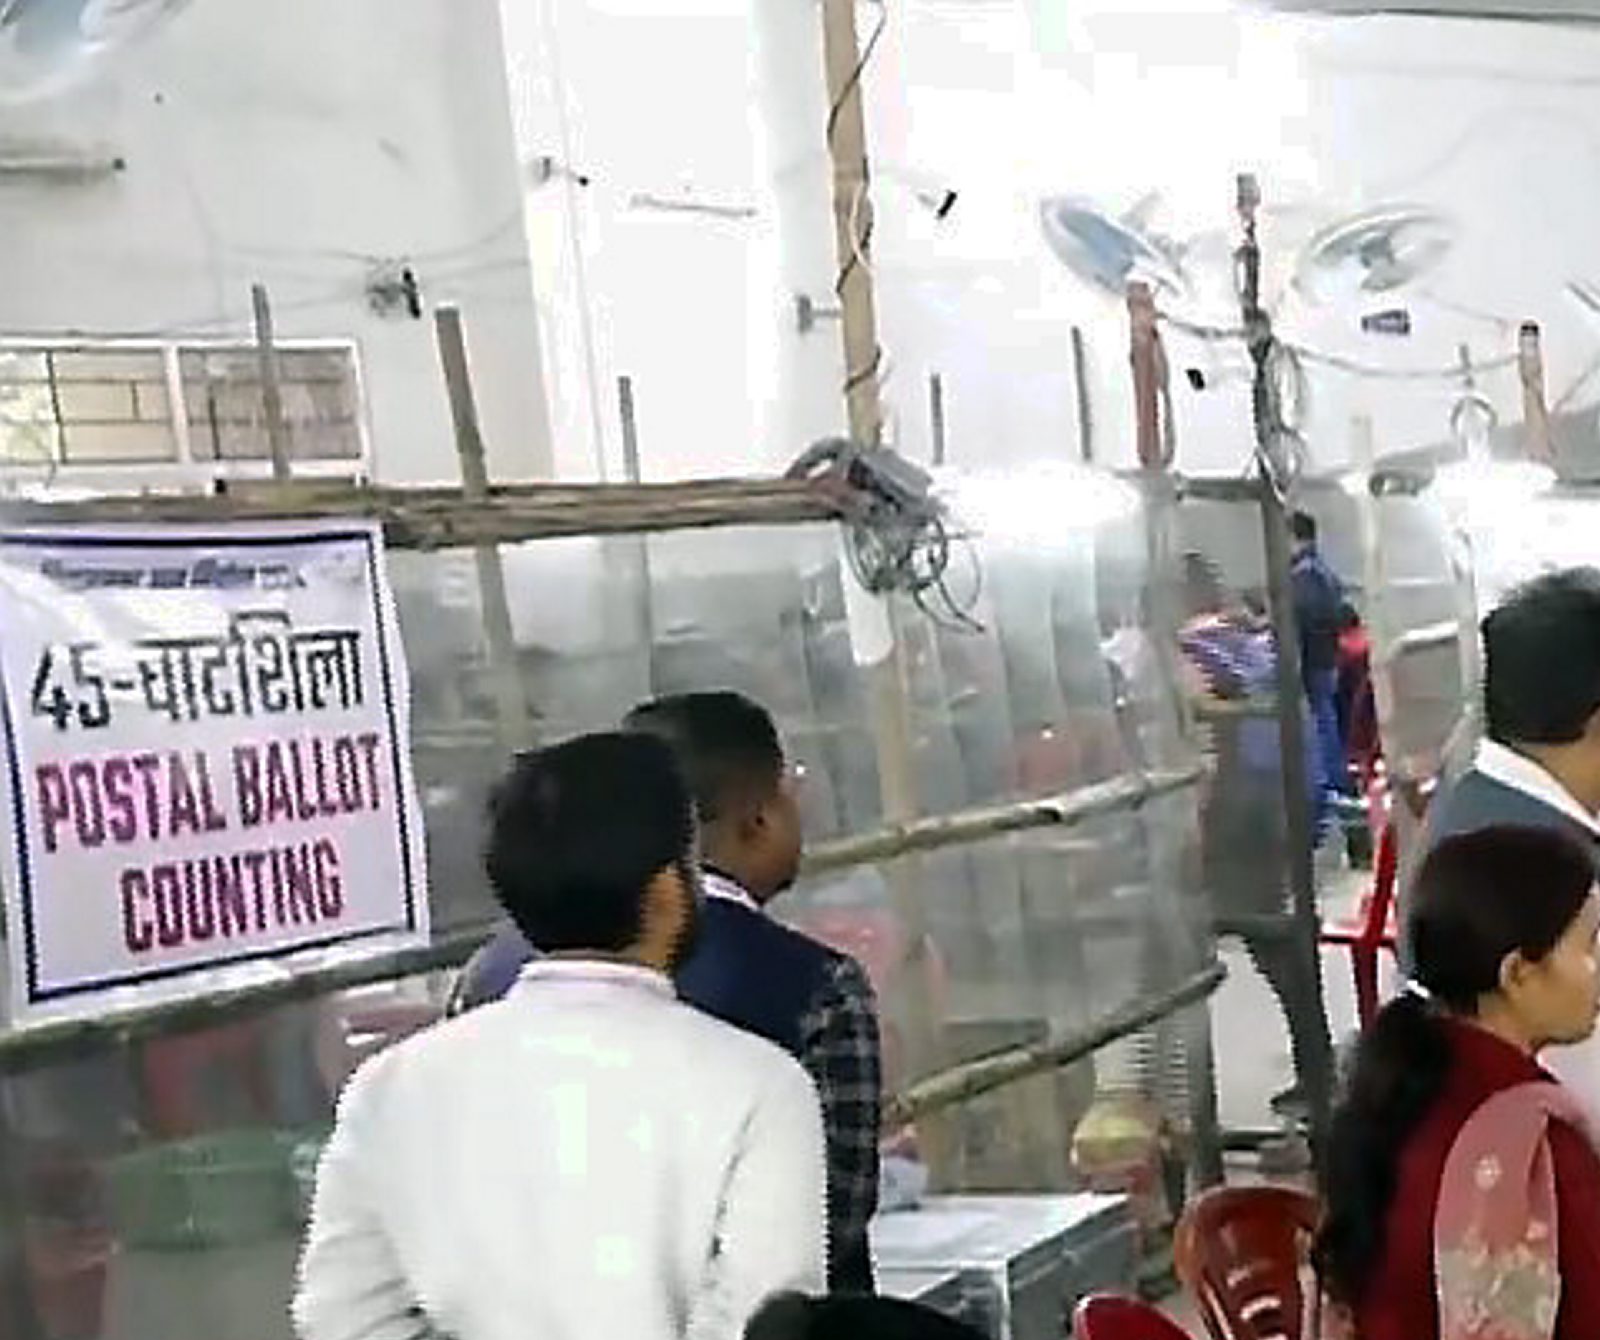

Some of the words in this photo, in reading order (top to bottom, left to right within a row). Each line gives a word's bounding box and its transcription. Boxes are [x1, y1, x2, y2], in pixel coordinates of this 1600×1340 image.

[36, 752, 227, 853] POSTAL
[234, 733, 382, 828] BALLOT
[121, 838, 344, 953] COUNTING
